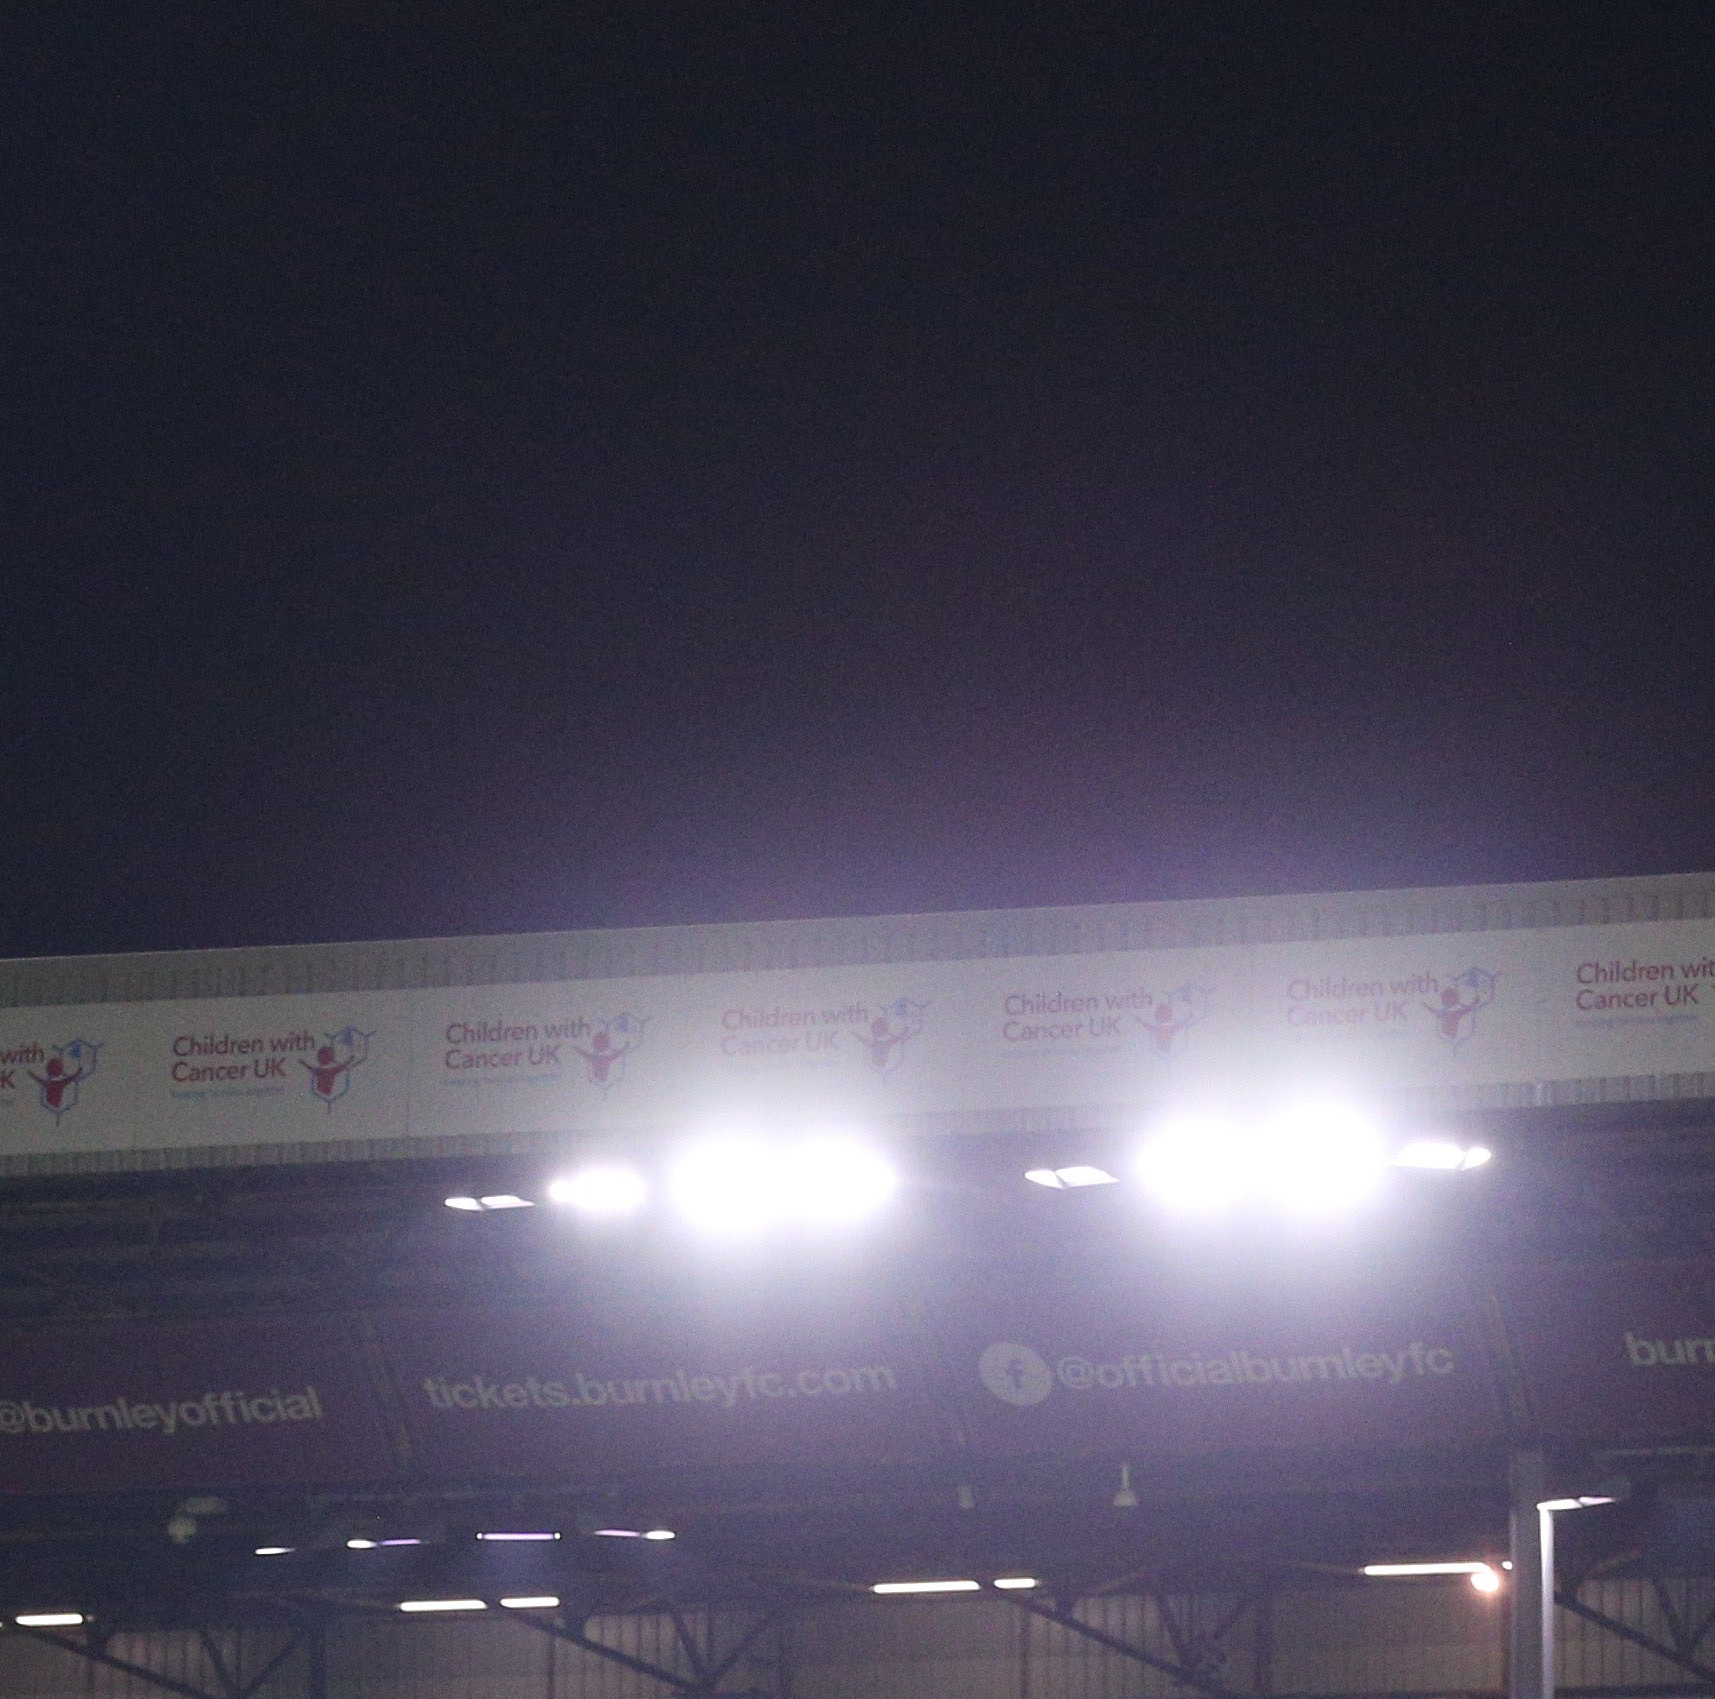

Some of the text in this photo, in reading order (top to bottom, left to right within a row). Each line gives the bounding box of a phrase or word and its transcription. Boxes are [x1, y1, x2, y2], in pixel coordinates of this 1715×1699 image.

[1576, 959, 1676, 985] Children
[1575, 982, 1700, 1010] Cancer UK
[172, 1030, 317, 1057] Children with
[171, 1056, 287, 1082] Cancer UK
[1056, 1339, 1456, 1394] @officialburnleyfc
[421, 1361, 897, 1413] tickets.burnleyfc.com
